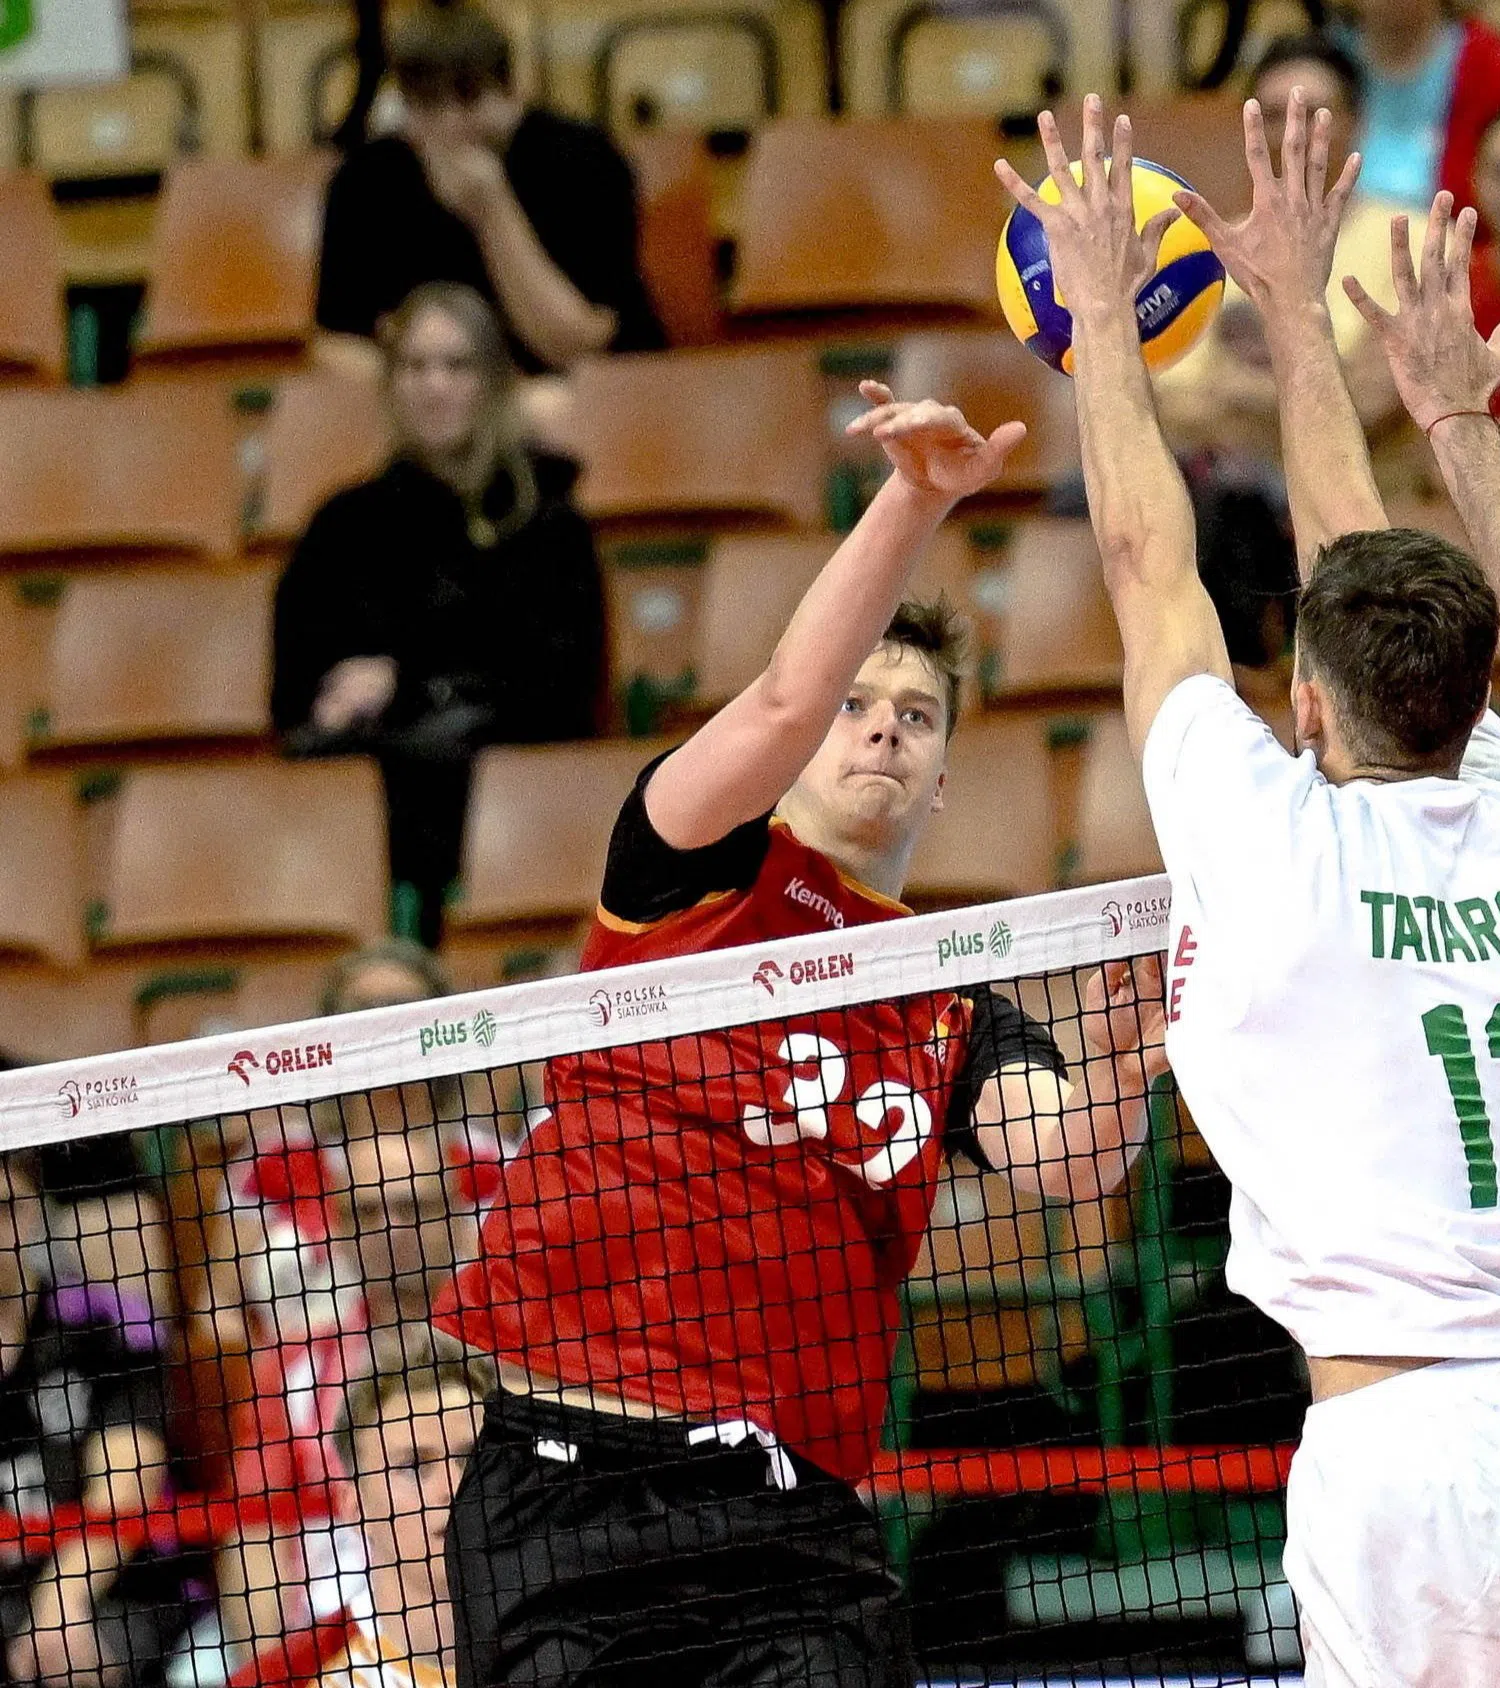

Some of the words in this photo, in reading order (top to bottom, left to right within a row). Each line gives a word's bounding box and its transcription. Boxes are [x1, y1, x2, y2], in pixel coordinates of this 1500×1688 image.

[938, 929, 985, 967] plus
[790, 952, 854, 986] ORLEN
[615, 984, 667, 1005] POLSKA
[419, 1018, 468, 1057] plus
[265, 1042, 333, 1075] ORLEN
[85, 1076, 138, 1095] POLSKA
